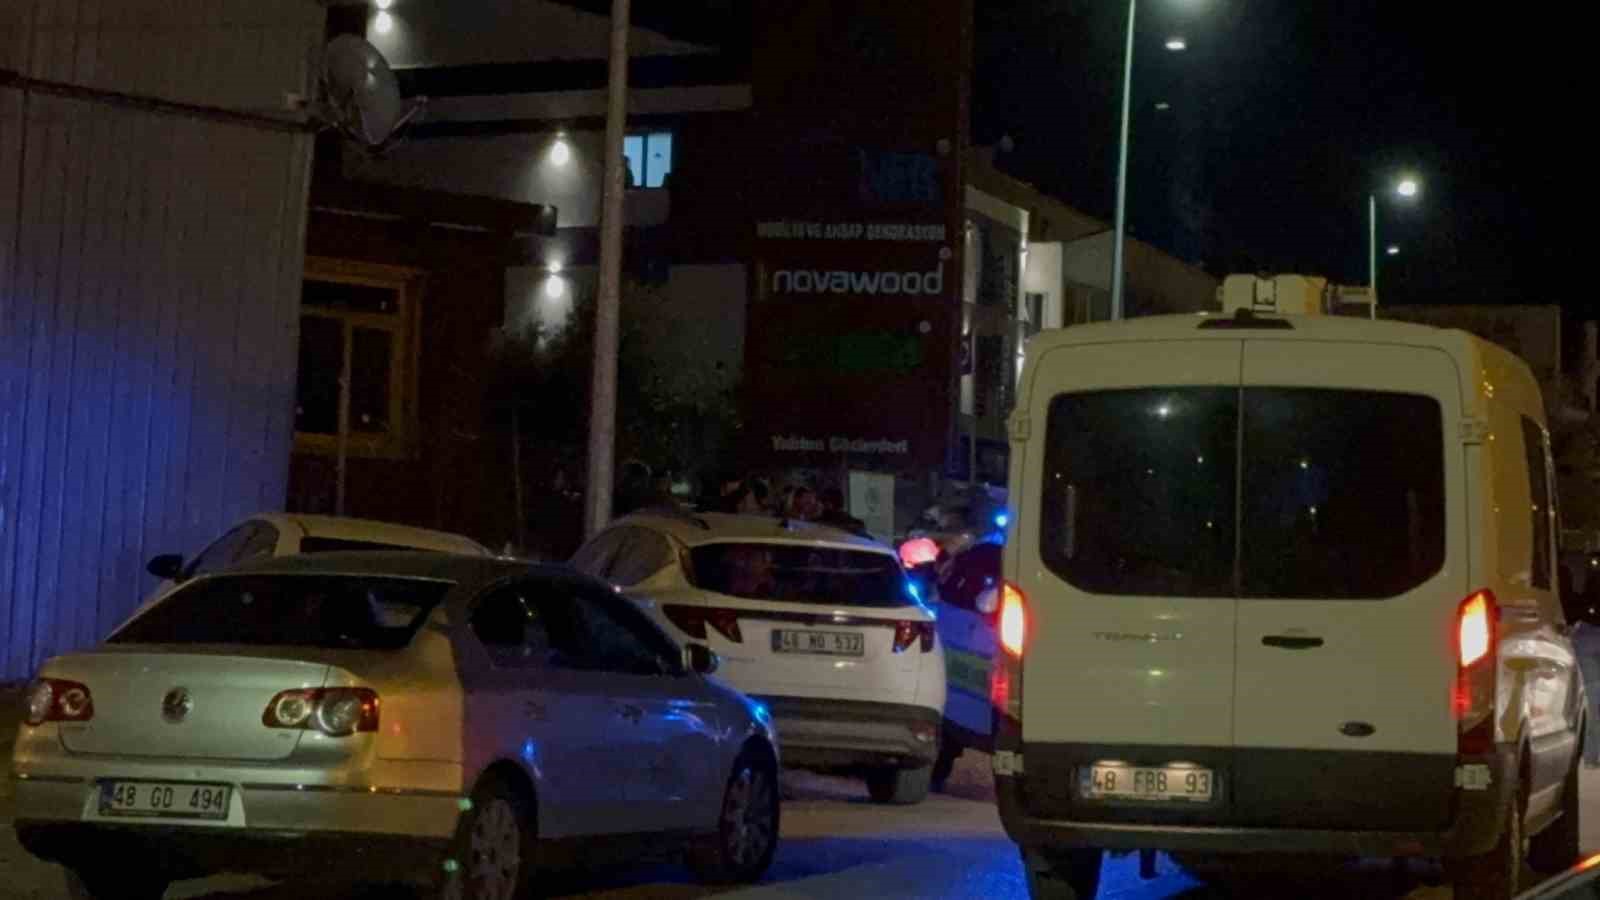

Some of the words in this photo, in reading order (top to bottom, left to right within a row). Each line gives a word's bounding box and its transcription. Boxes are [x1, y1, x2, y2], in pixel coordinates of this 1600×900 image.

[772, 260, 945, 296] novawood
[1093, 769, 1116, 791] 48
[1184, 772, 1210, 794] 93
[112, 784, 137, 807] 48
[189, 788, 225, 810] 494
